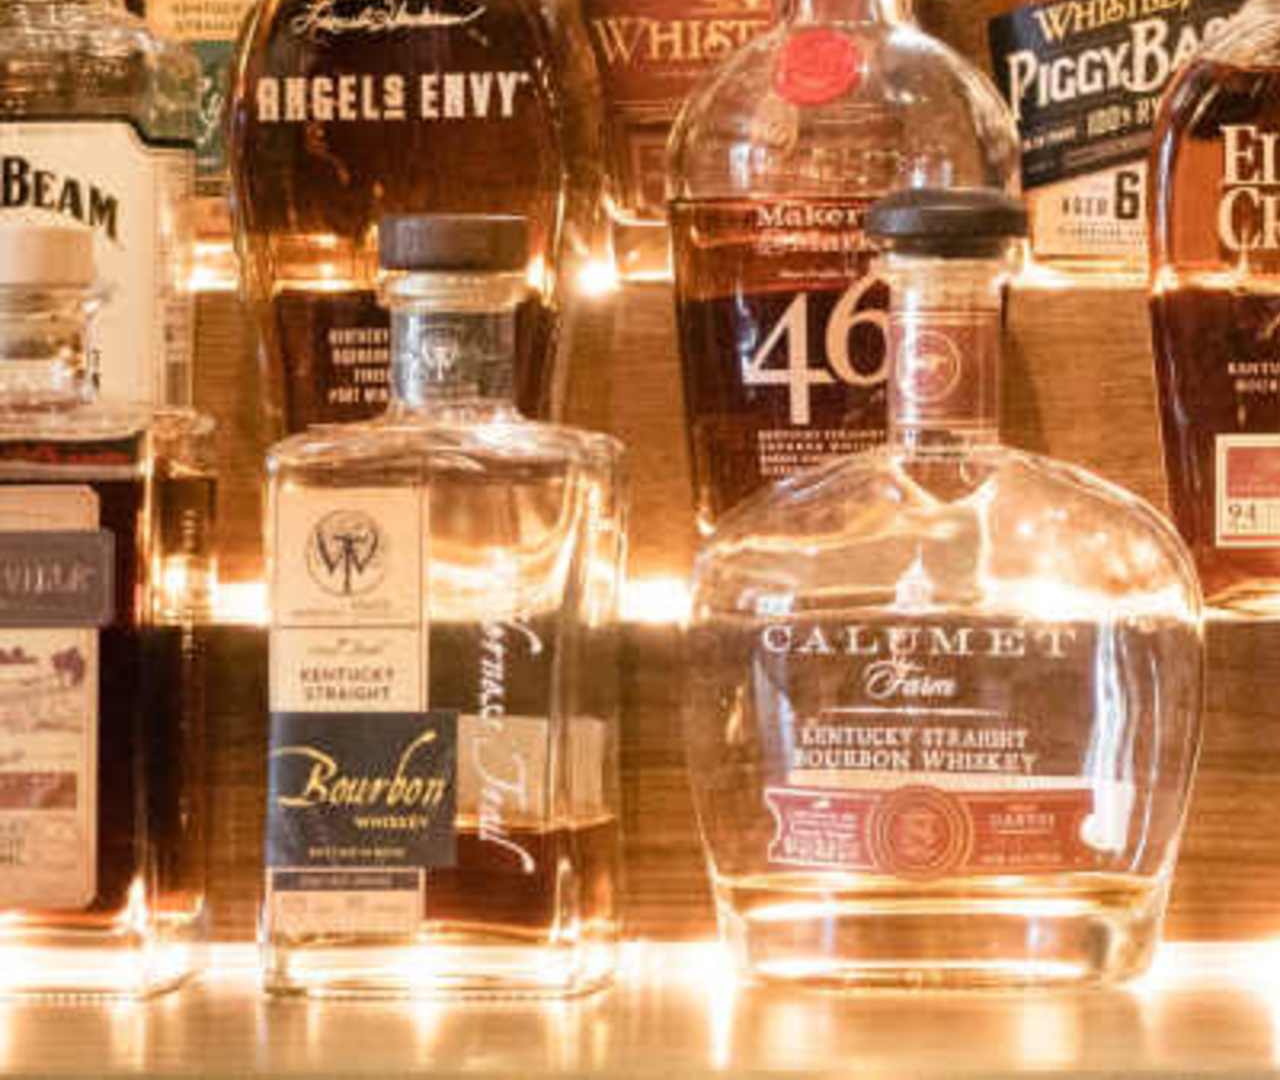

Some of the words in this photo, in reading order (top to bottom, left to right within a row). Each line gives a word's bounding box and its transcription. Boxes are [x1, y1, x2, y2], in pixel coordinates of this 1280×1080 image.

[596, 16, 763, 63] WHIST
[420, 72, 518, 120] ENVY
[1115, 171, 1141, 220] 6
[740, 258, 894, 426] 46
[761, 622, 1079, 660] CALUMET
[300, 667, 395, 683] KENTUCKY
[304, 685, 391, 702] STRAIGHT
[864, 653, 958, 700] Farm
[801, 725, 914, 748] KENTUCKY
[921, 726, 1029, 749] STRAIGHT
[272, 729, 449, 808] Bourbon
[790, 748, 911, 771] BOURBON
[921, 749, 1038, 774] WHISKEY
